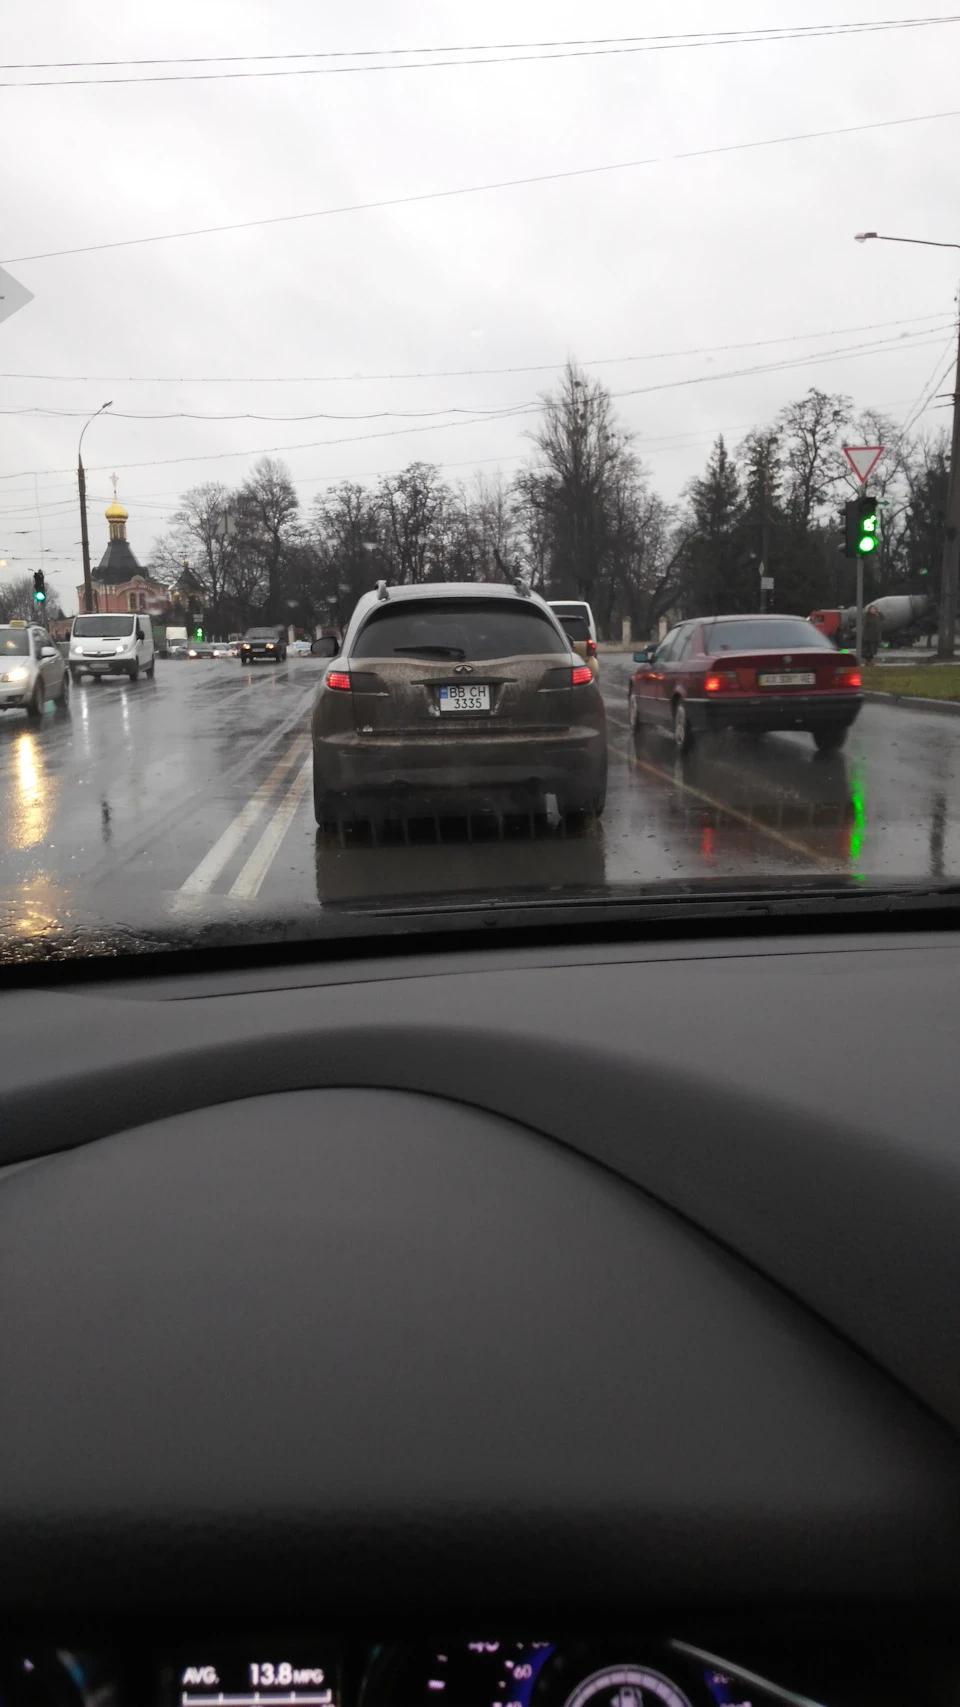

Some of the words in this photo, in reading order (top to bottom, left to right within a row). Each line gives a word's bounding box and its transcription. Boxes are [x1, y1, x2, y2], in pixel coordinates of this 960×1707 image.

[449, 687, 466, 698] BB
[469, 686, 486, 697] CH
[454, 698, 482, 709] 3335
[182, 1666, 220, 1685] AVG.
[513, 1663, 532, 1680] 60
